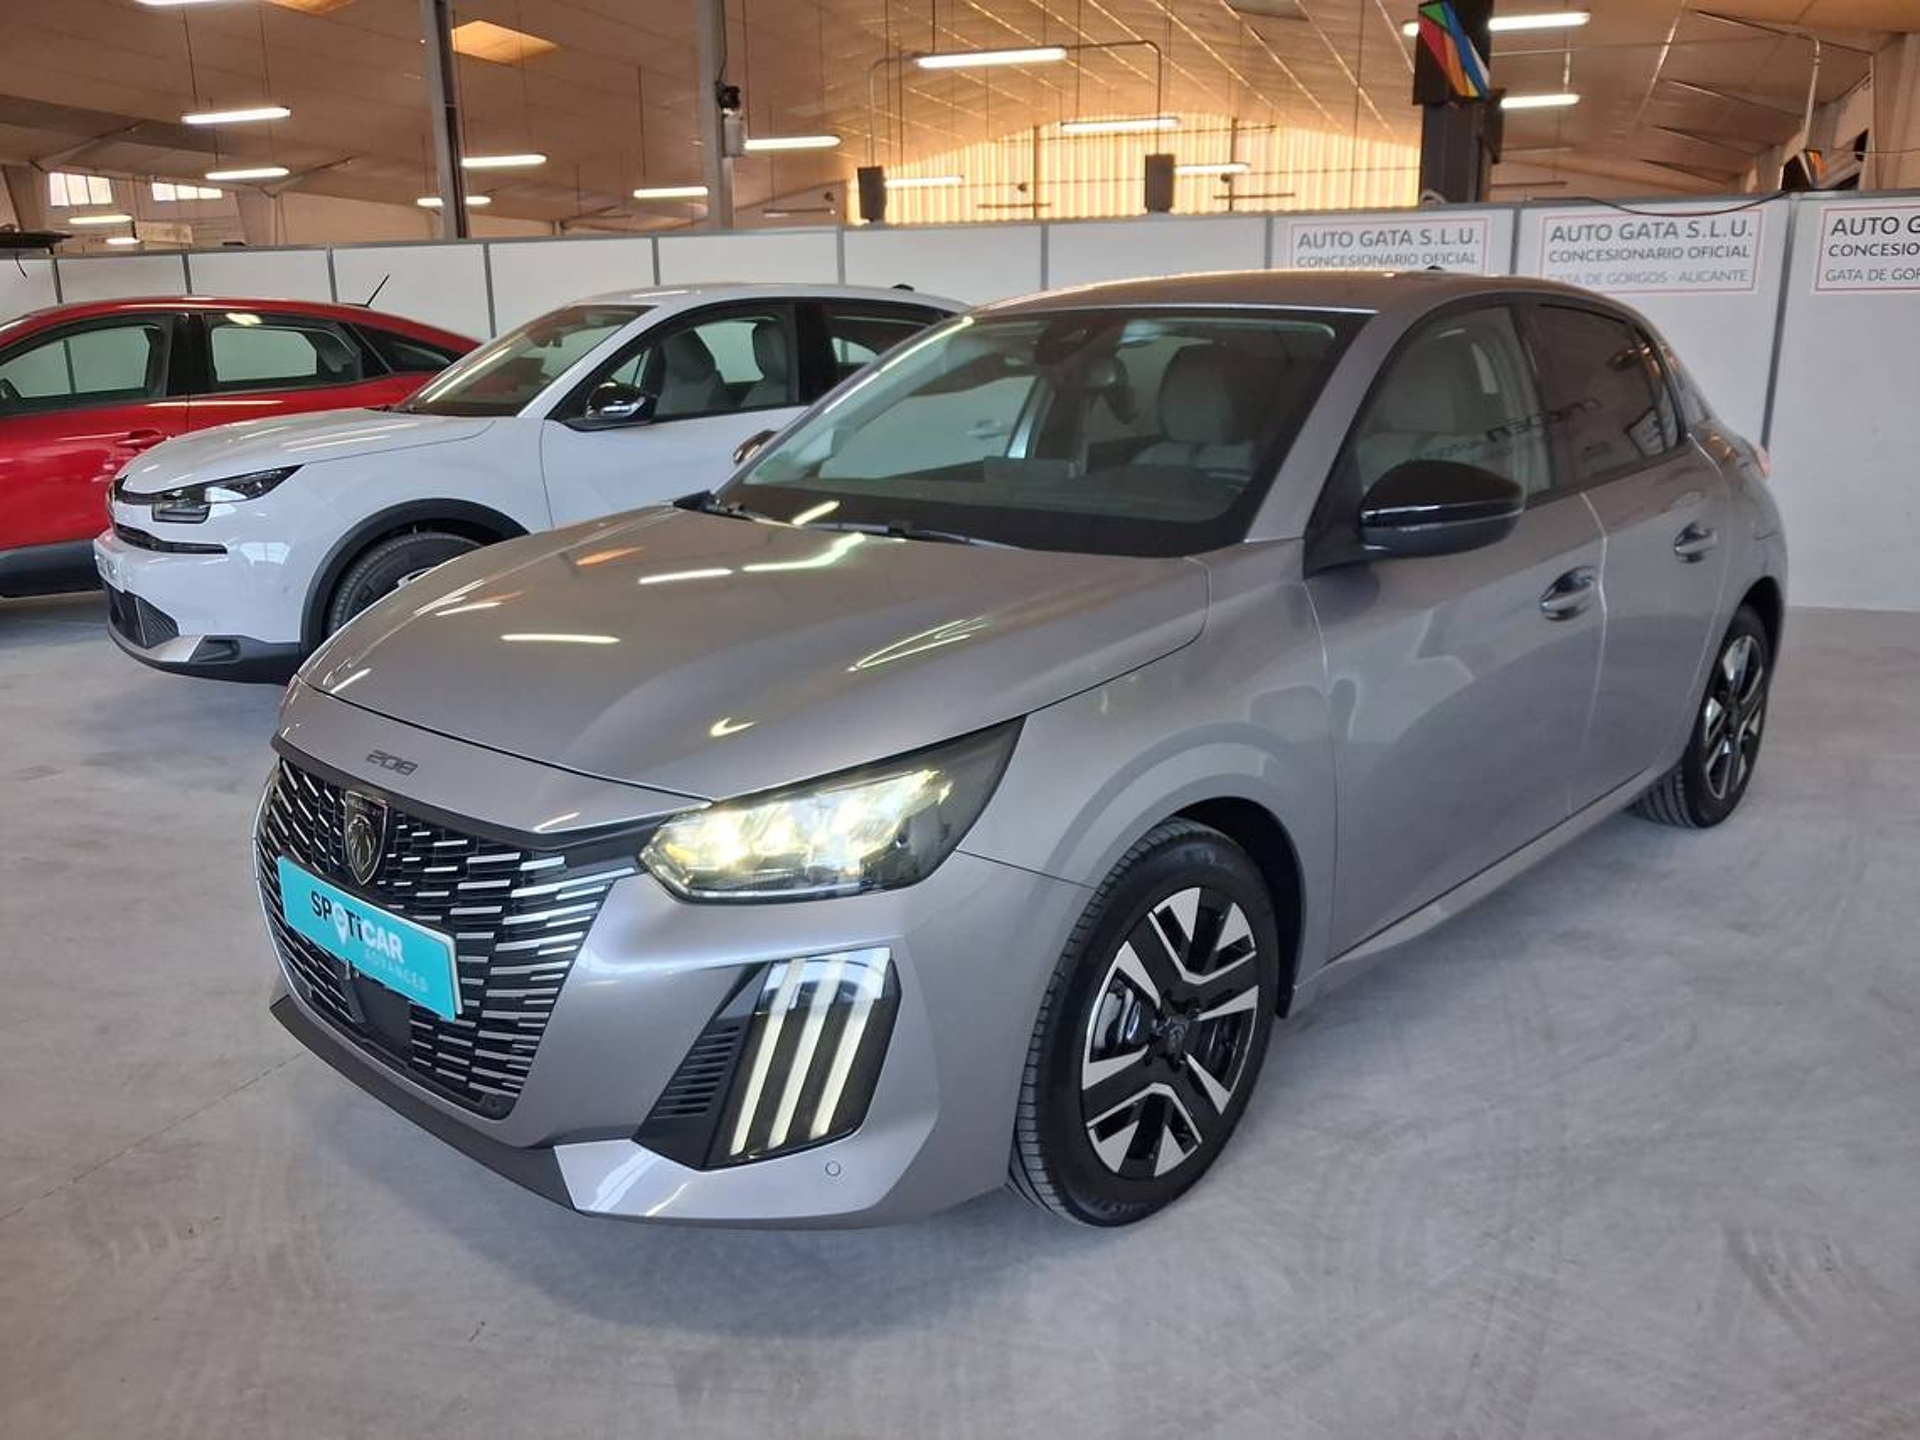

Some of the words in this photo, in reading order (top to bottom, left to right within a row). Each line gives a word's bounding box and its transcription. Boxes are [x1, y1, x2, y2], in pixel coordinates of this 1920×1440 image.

[1550, 224, 1612, 242] AUTO
[1619, 222, 1679, 240] GATA
[1685, 219, 1753, 238] S.L.U.
[1831, 216, 1900, 236] AUTO
[1297, 231, 1354, 249] AUTO
[1360, 229, 1414, 247] GATA
[1420, 228, 1480, 245] S.L.U.
[1549, 247, 1685, 263] CONCESIONARIO
[1687, 245, 1750, 259] OFICIAL
[1828, 243, 1920, 256] CONCESIO
[1297, 252, 1418, 268] CONCESIONARIO
[1421, 251, 1477, 265] OFICIAL
[1585, 272, 1602, 285] DE
[1607, 271, 1667, 284] GORGOS
[1678, 269, 1748, 283] ALICANTE
[1825, 268, 1863, 281] GATA
[1868, 268, 1887, 281] DE
[366, 750, 418, 777] 208
